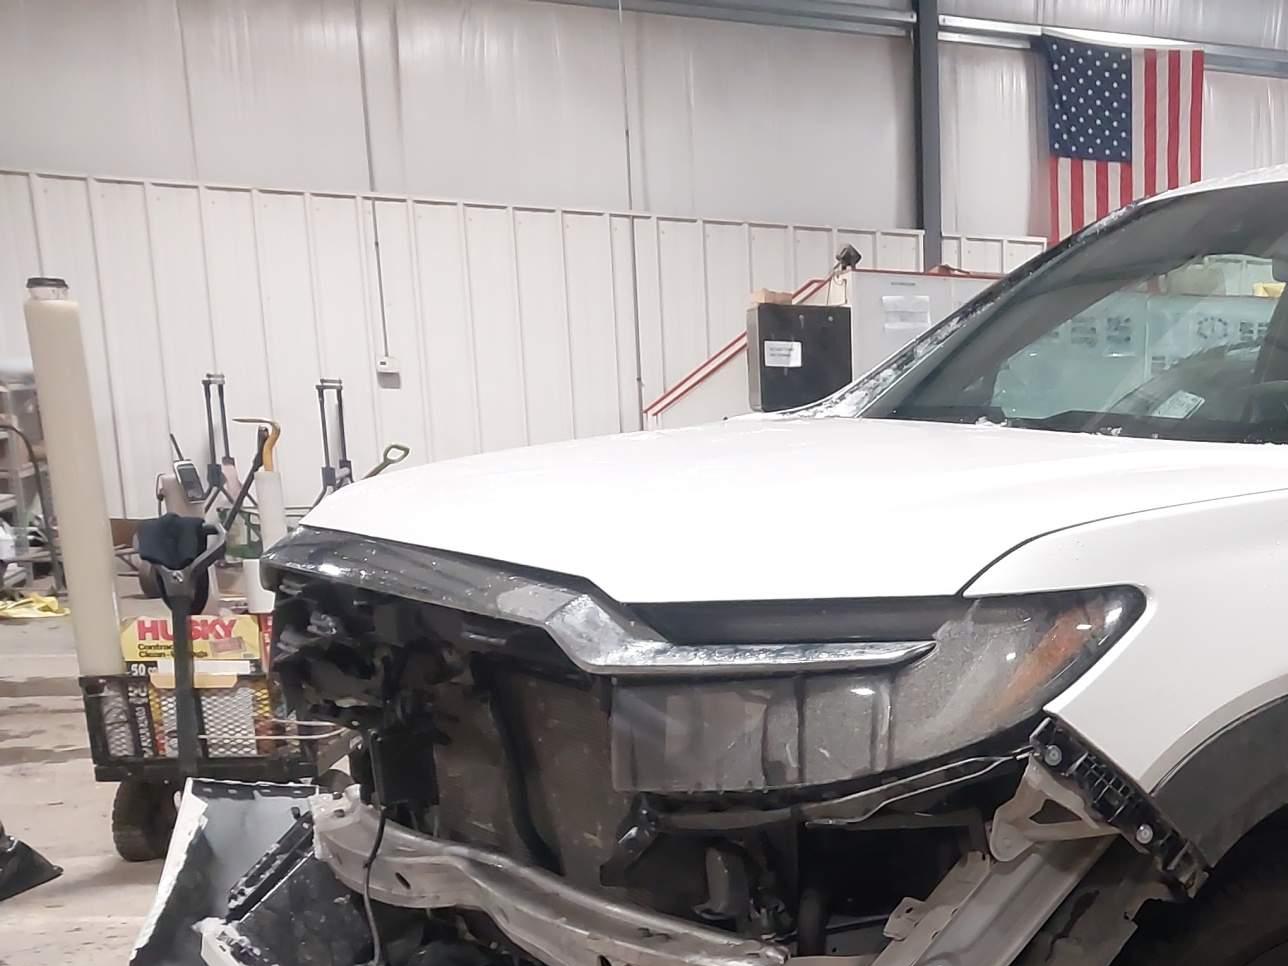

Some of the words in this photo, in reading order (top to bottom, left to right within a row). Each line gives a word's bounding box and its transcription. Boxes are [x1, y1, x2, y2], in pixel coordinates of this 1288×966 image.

[137, 618, 236, 641] HUSKY
[138, 643, 174, 651] Contrac
[130, 663, 146, 677] 50
